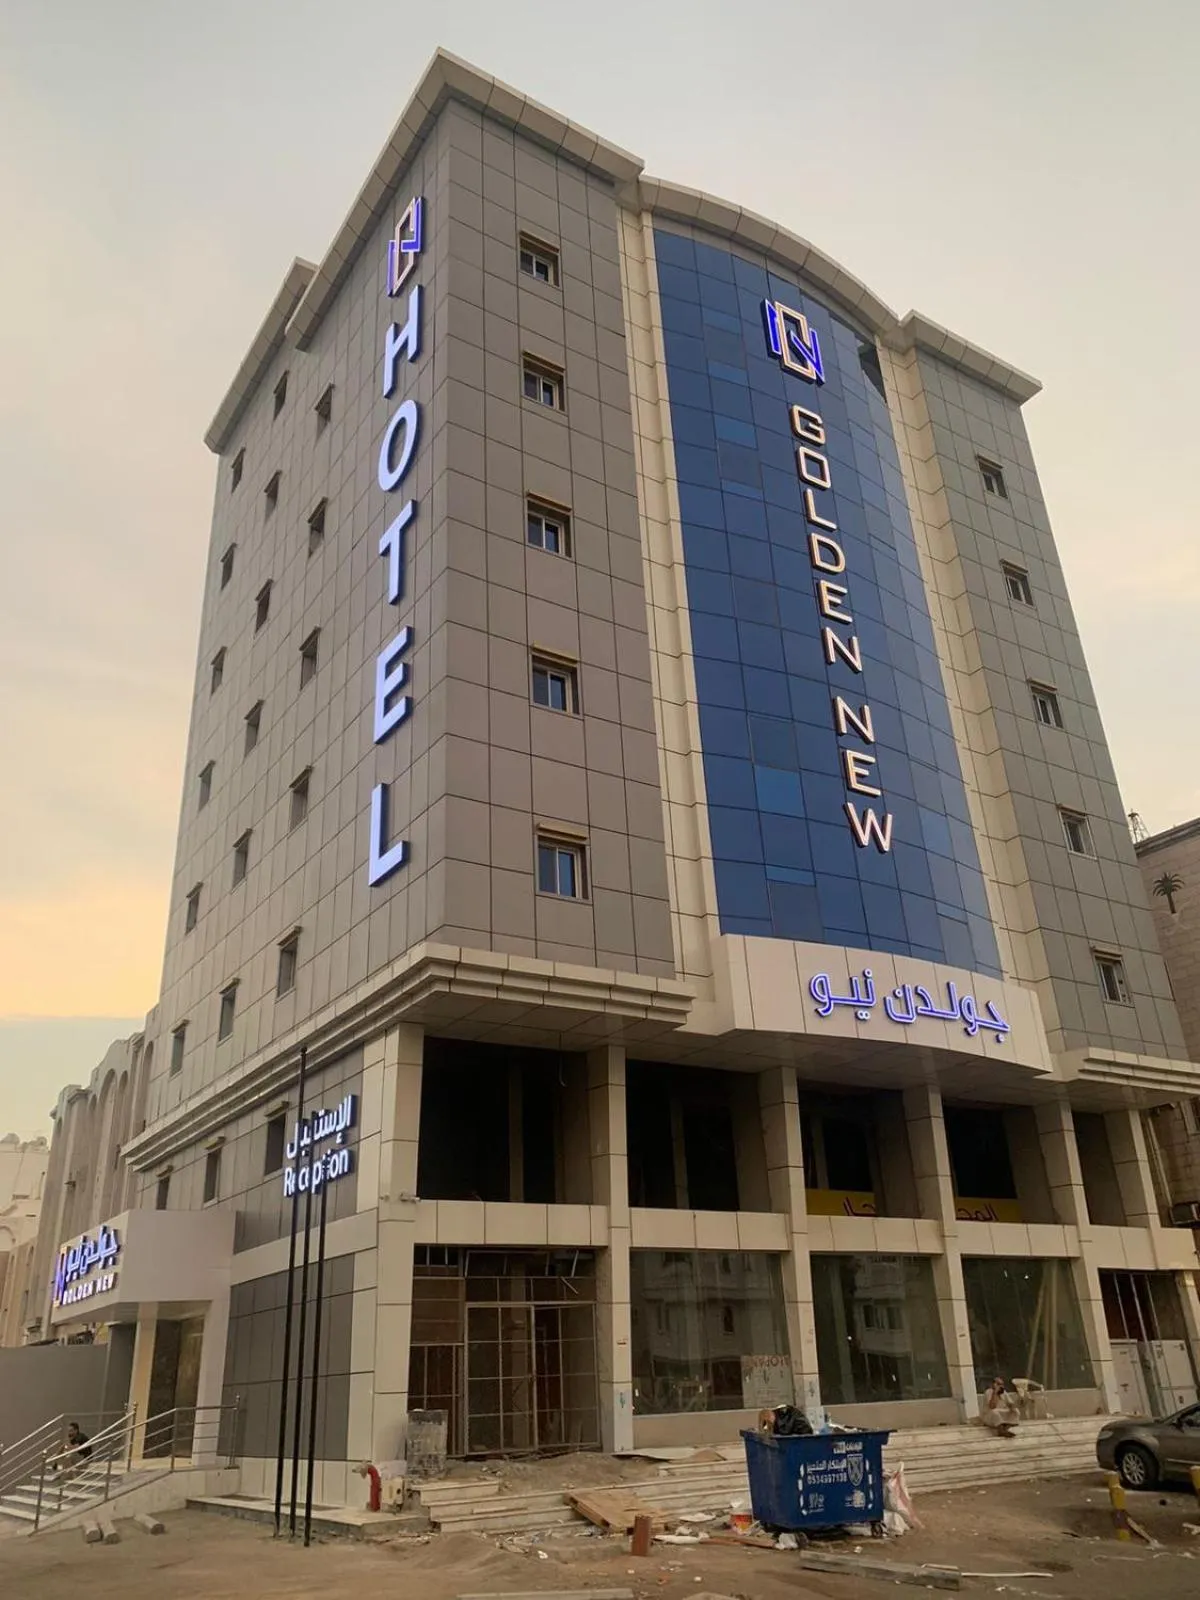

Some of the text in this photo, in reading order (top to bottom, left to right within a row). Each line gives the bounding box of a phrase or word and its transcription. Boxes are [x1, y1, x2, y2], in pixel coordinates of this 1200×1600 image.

[368, 284, 421, 887] HOTEL
[791, 404, 893, 853] GOLDEN NEW
[809, 968, 1010, 1043] جولدن نيو
